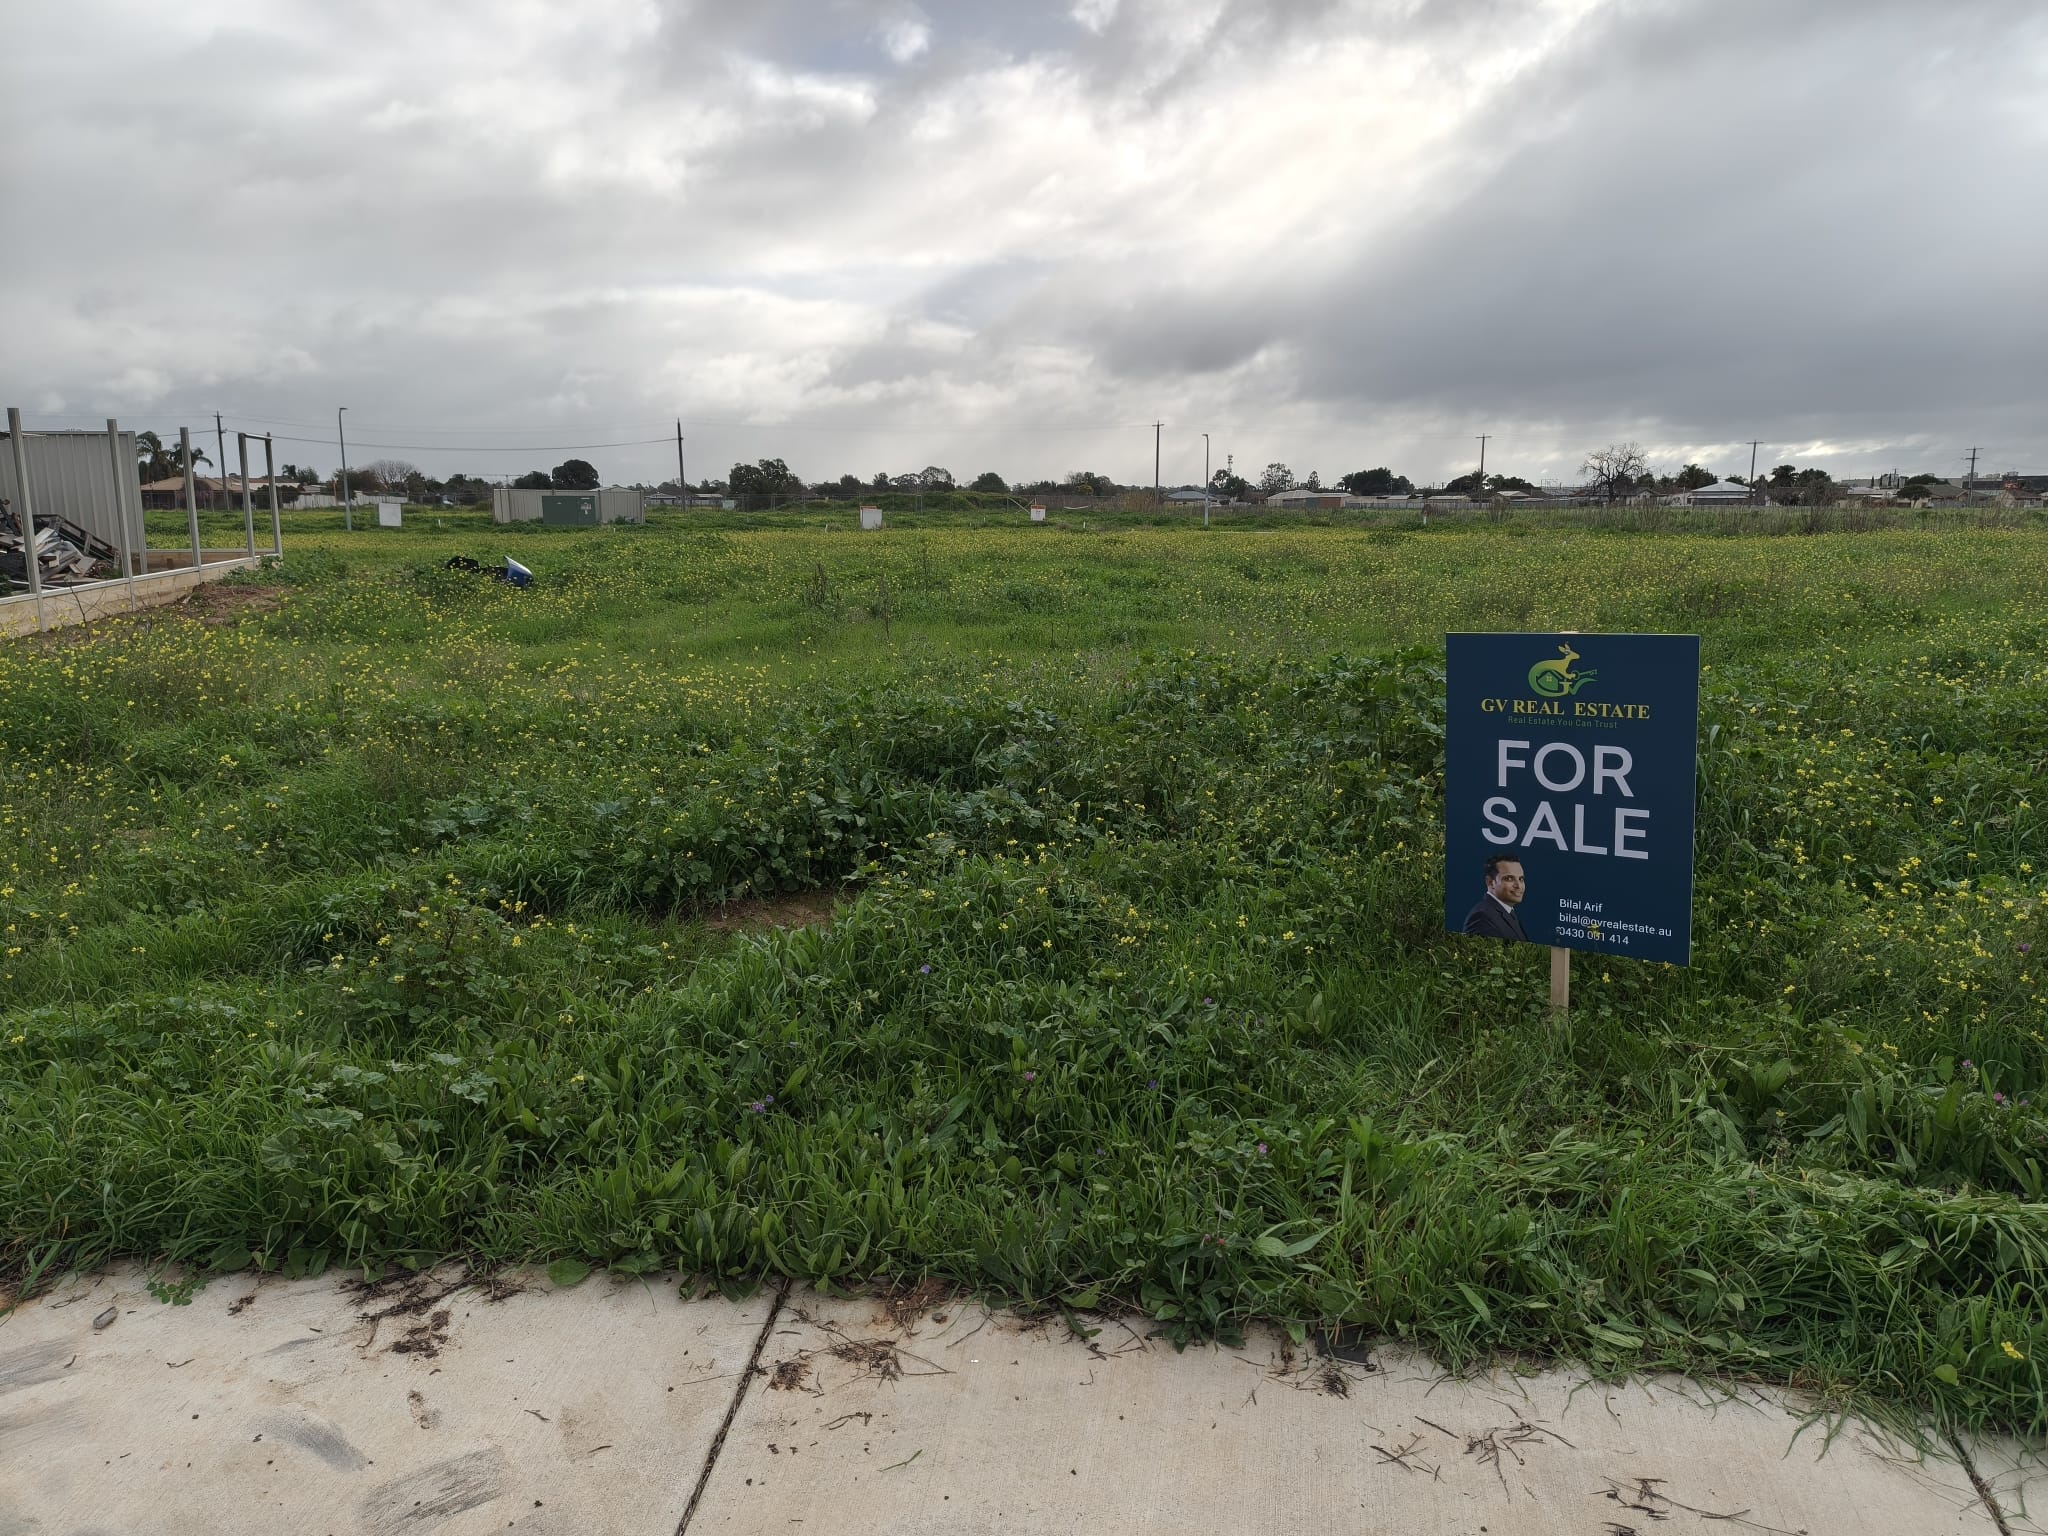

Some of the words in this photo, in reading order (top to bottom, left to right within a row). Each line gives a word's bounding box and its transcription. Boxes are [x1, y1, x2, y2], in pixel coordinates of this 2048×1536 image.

[1481, 699, 1508, 712] GV
[1513, 699, 1564, 715] REAL
[1574, 702, 1650, 719] ESTATE
[1508, 716, 1525, 724] Real
[1528, 717, 1555, 726] Estate
[1557, 718, 1573, 727] You
[1575, 719, 1592, 728] Can
[1595, 720, 1618, 729] Trust
[1497, 739, 1634, 797] FOR
[1481, 796, 1650, 860] SALE
[1559, 898, 1581, 910] Bilal
[1584, 902, 1603, 913] Arif
[1609, 934, 1629, 945] 414
